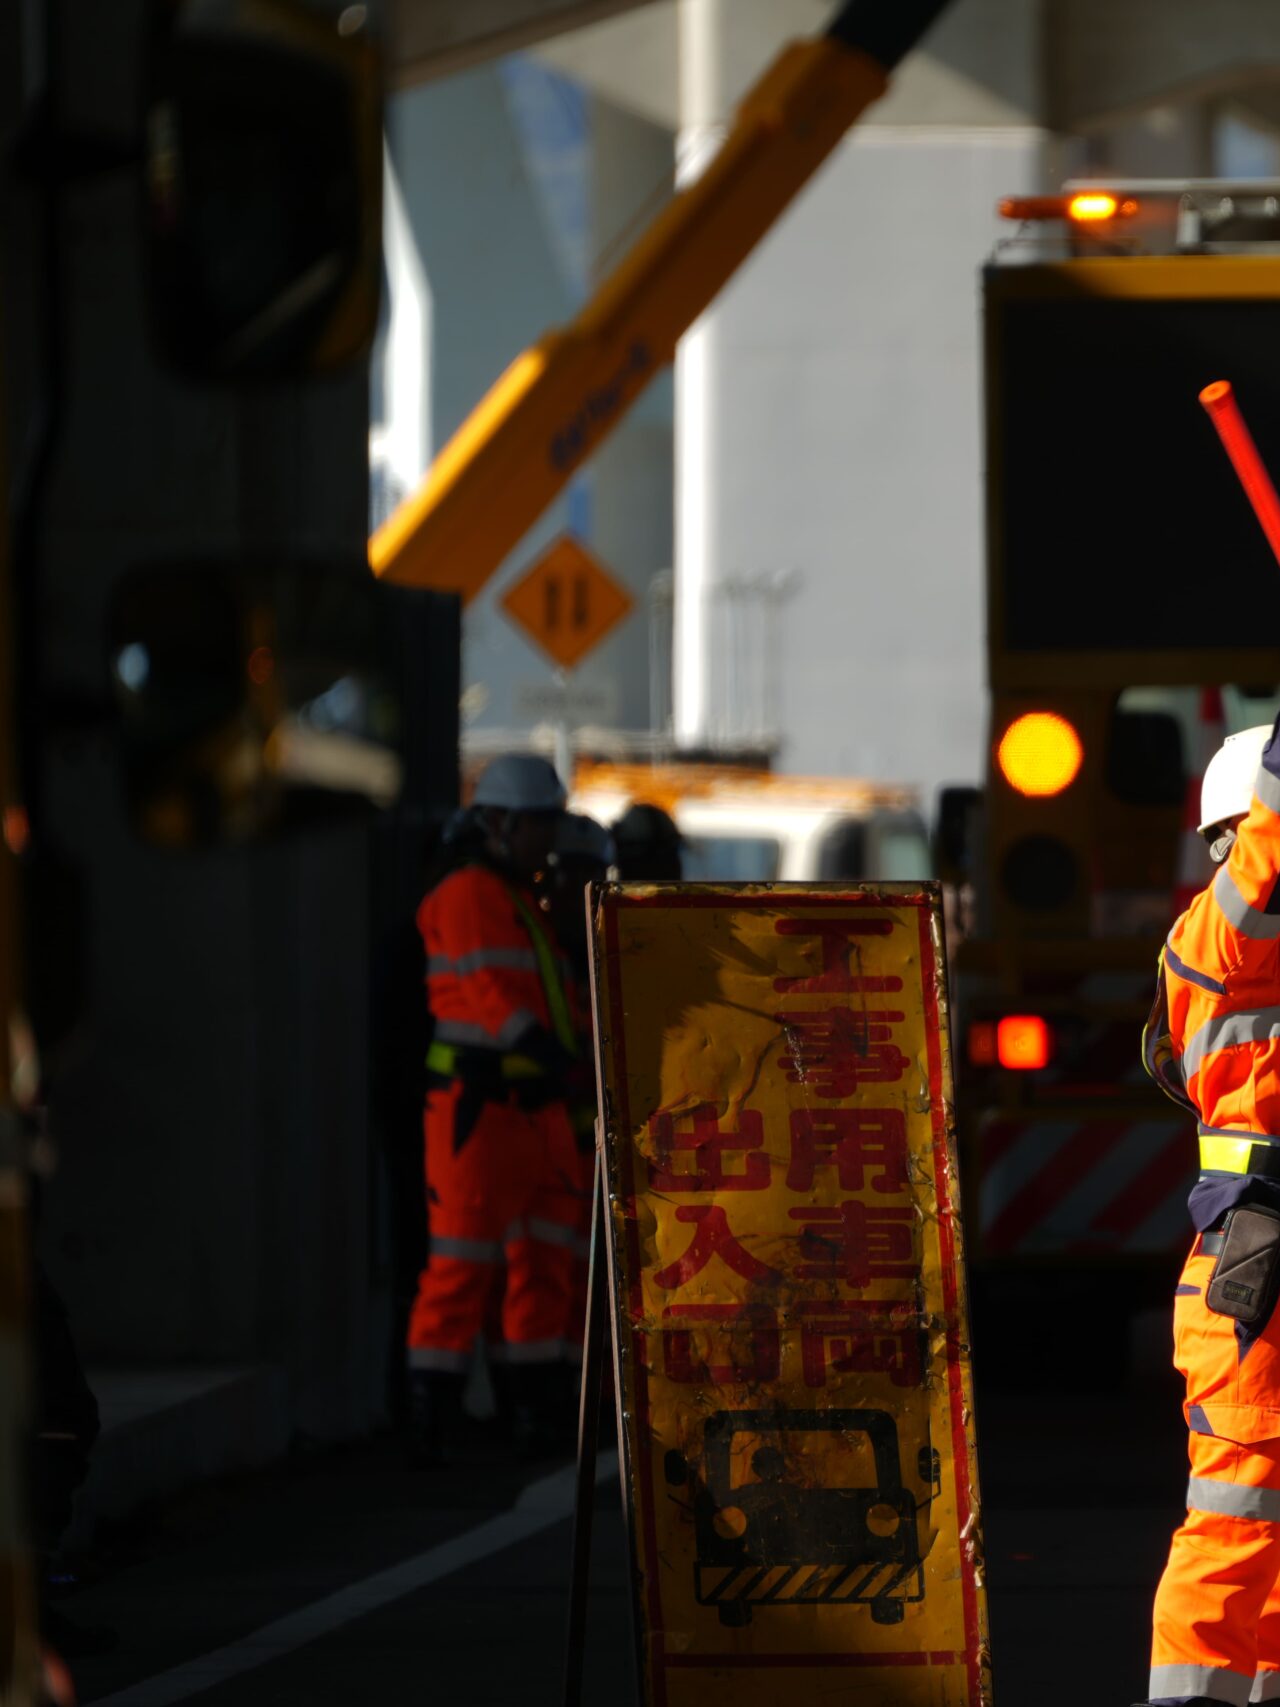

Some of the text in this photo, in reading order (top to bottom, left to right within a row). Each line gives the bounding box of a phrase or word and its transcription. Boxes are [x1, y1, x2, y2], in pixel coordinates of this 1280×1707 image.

[647, 1108, 780, 1387] 出入口
[773, 918, 925, 1387] 工事用車両
